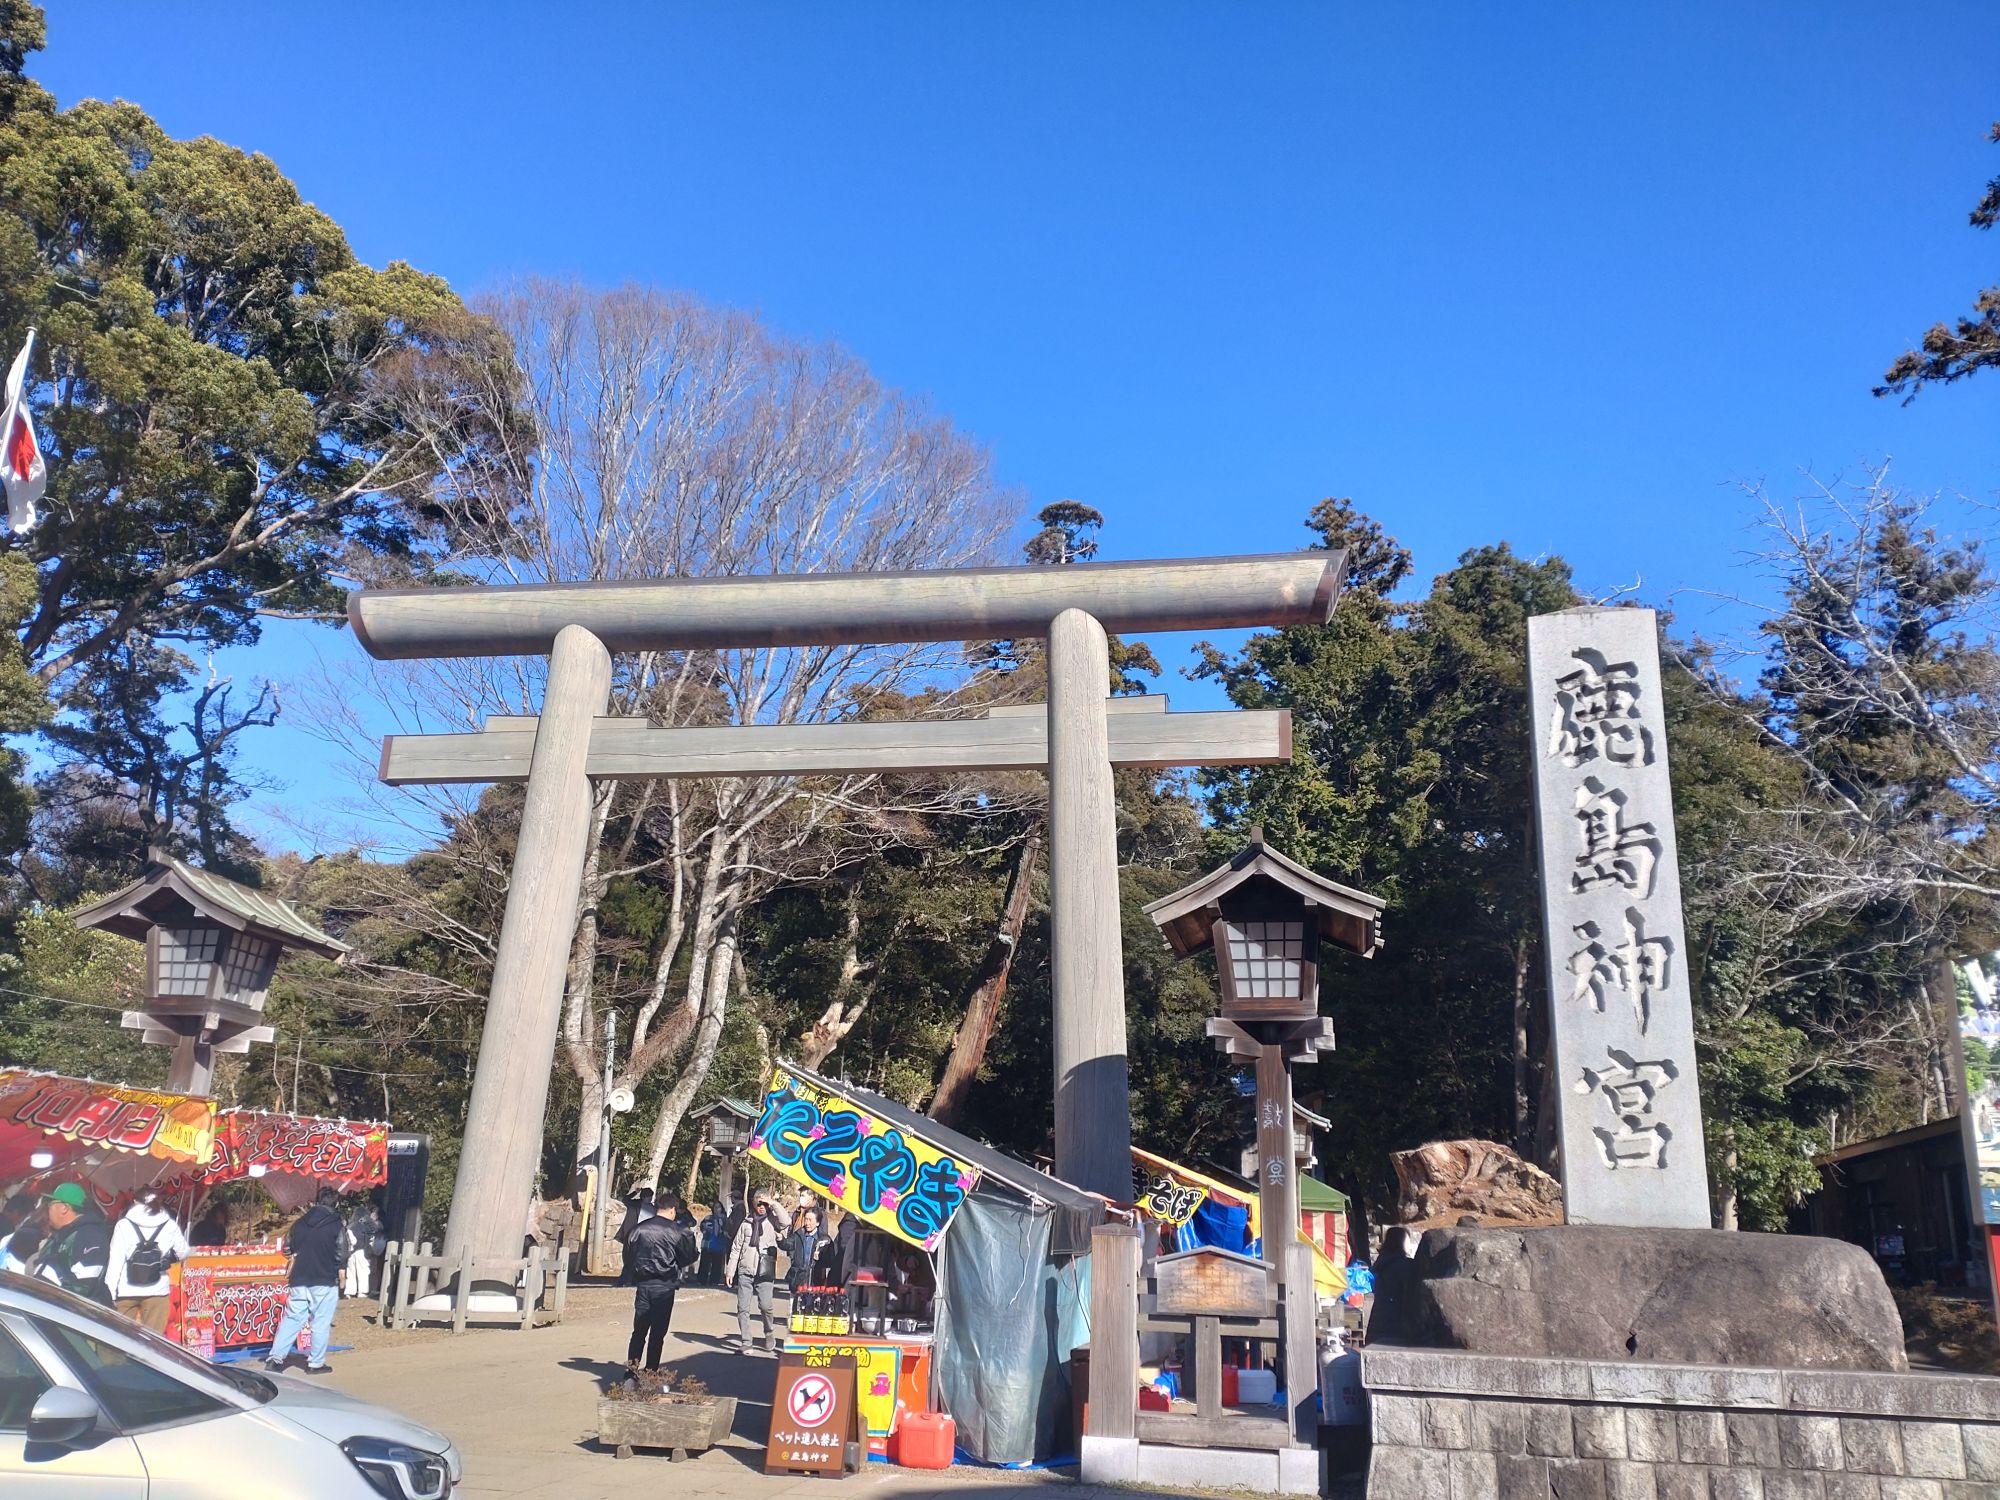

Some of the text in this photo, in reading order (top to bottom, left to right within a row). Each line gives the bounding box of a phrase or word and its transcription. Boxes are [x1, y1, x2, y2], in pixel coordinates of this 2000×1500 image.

[1545, 646, 1679, 1169] 鹿島神宮
[753, 1089, 966, 1239] たこやき
[774, 1432, 840, 1447] ペット進入禁止
